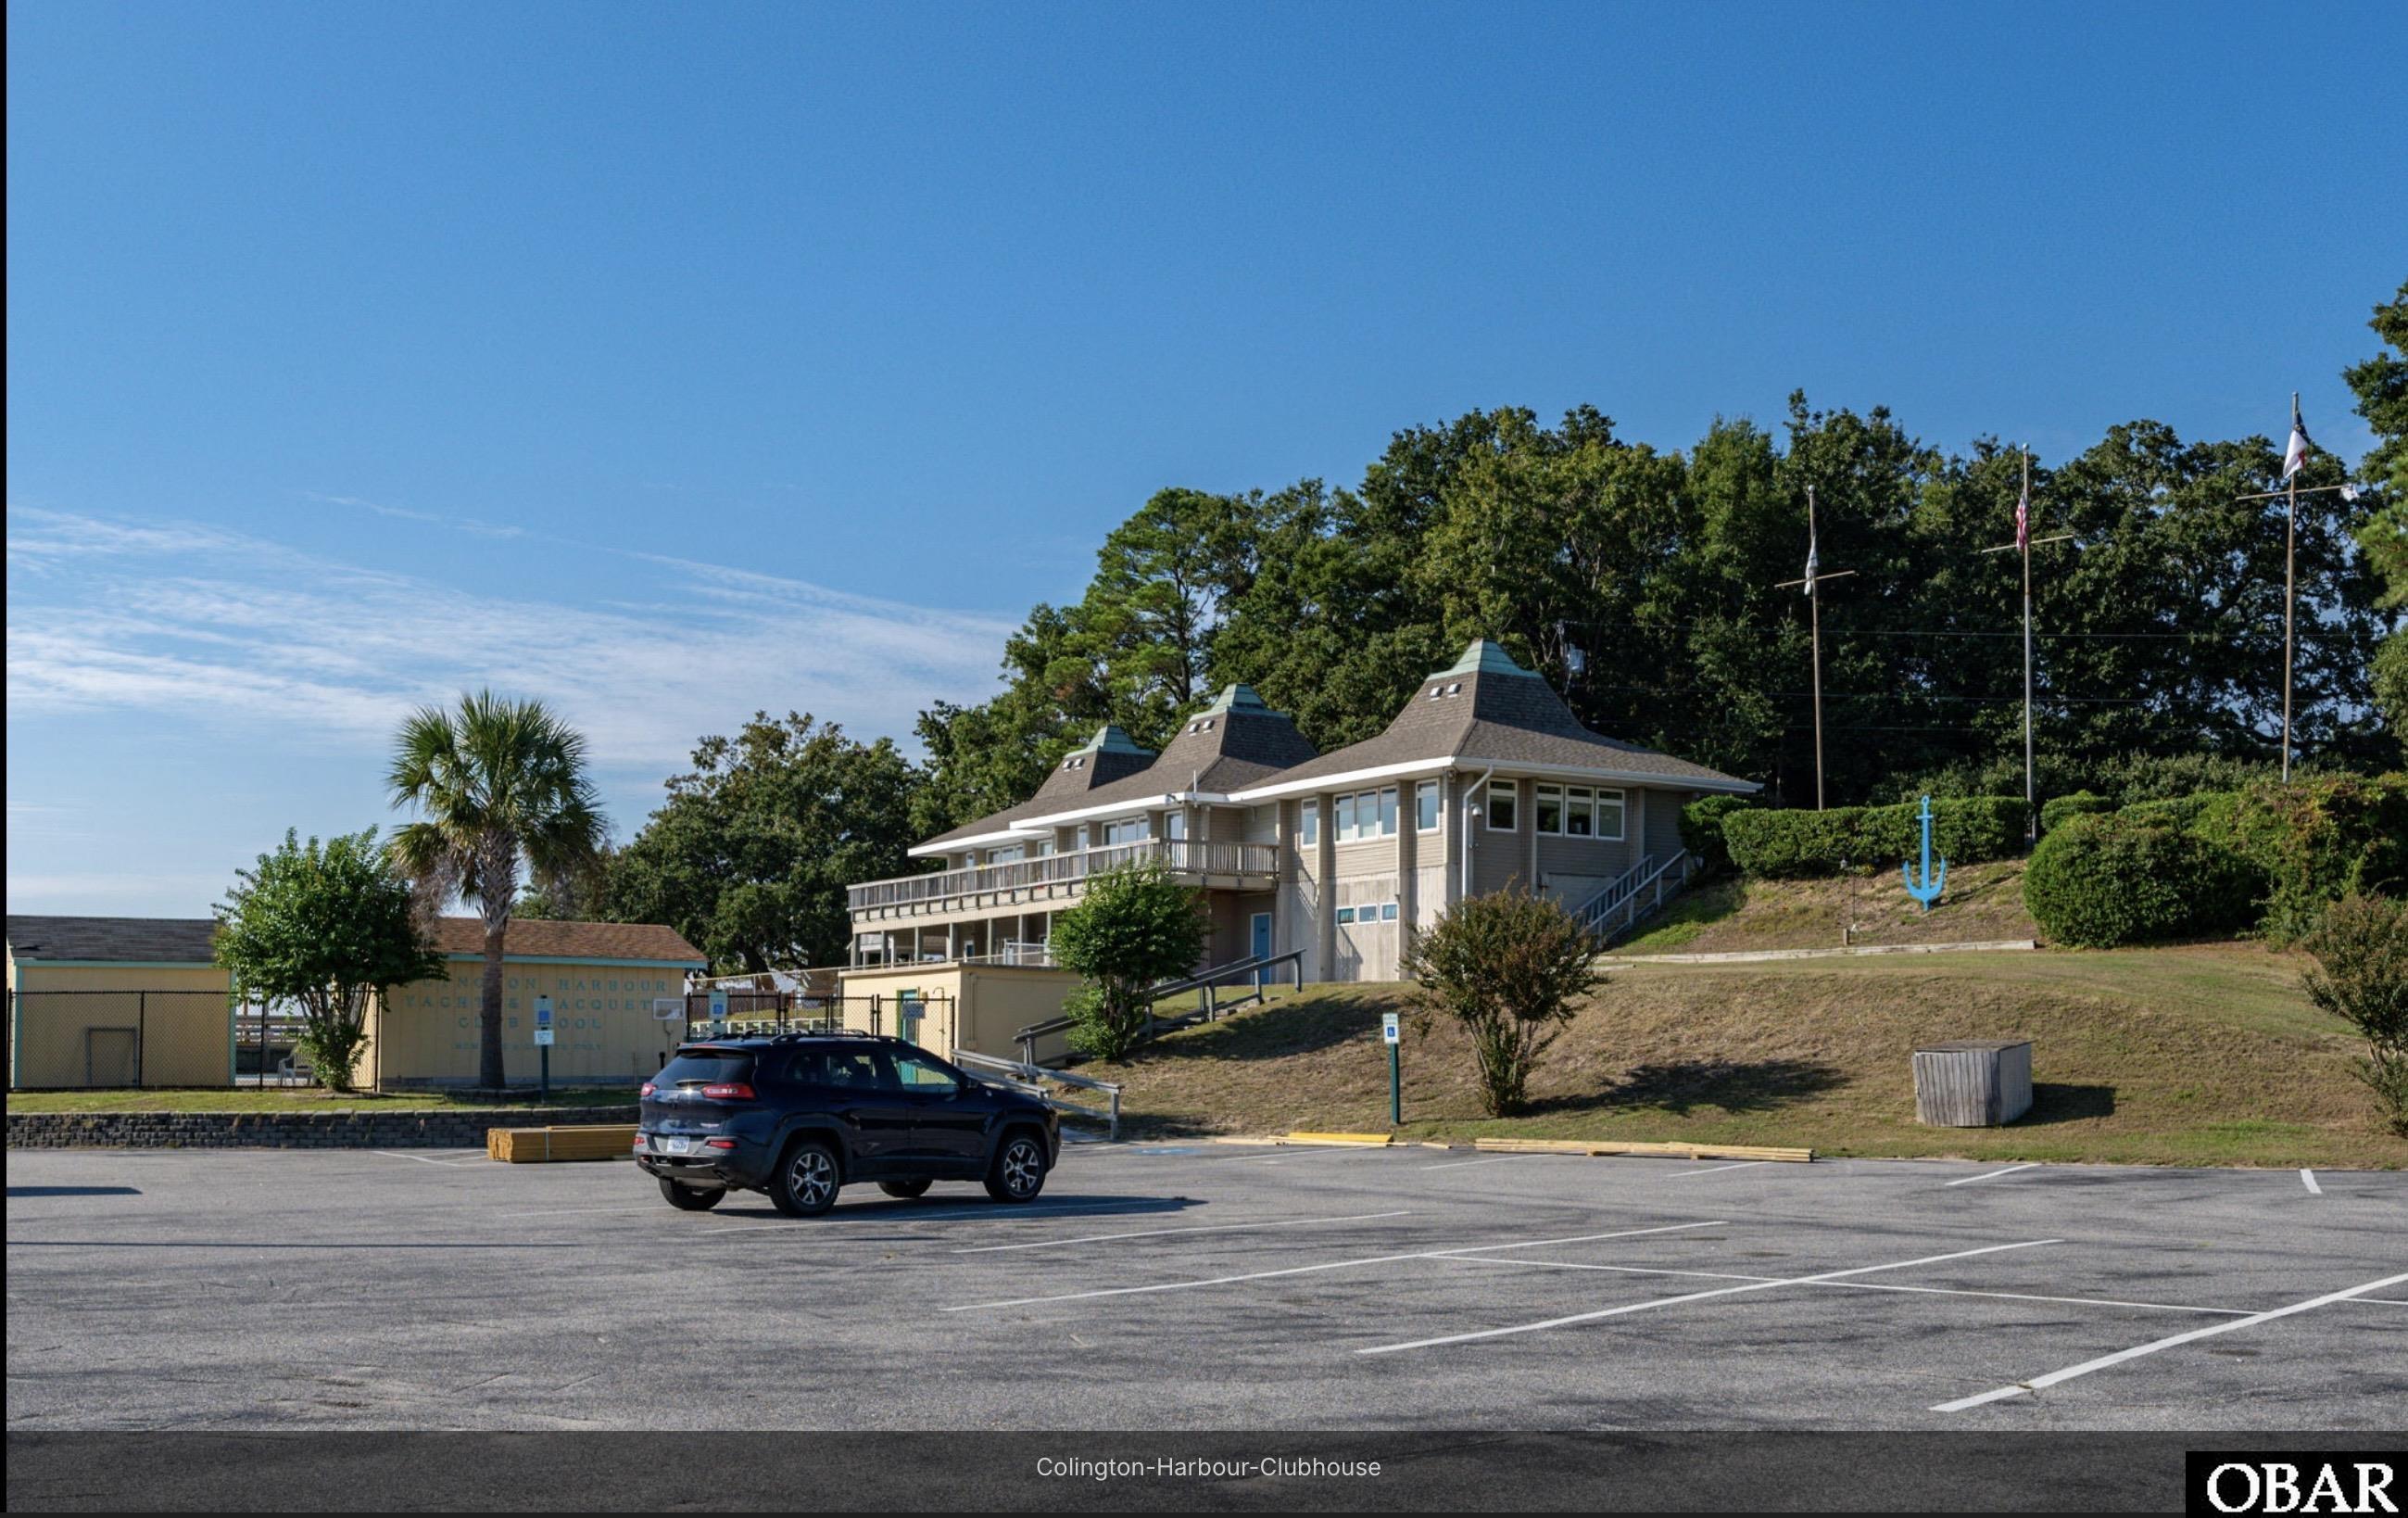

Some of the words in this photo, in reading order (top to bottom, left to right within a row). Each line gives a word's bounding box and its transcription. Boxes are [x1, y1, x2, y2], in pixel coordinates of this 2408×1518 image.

[559, 978, 666, 993] HARBOUR
[559, 999, 652, 1011] ACQUET
[459, 1017, 519, 1029] CLB
[559, 1018, 602, 1030] OOL
